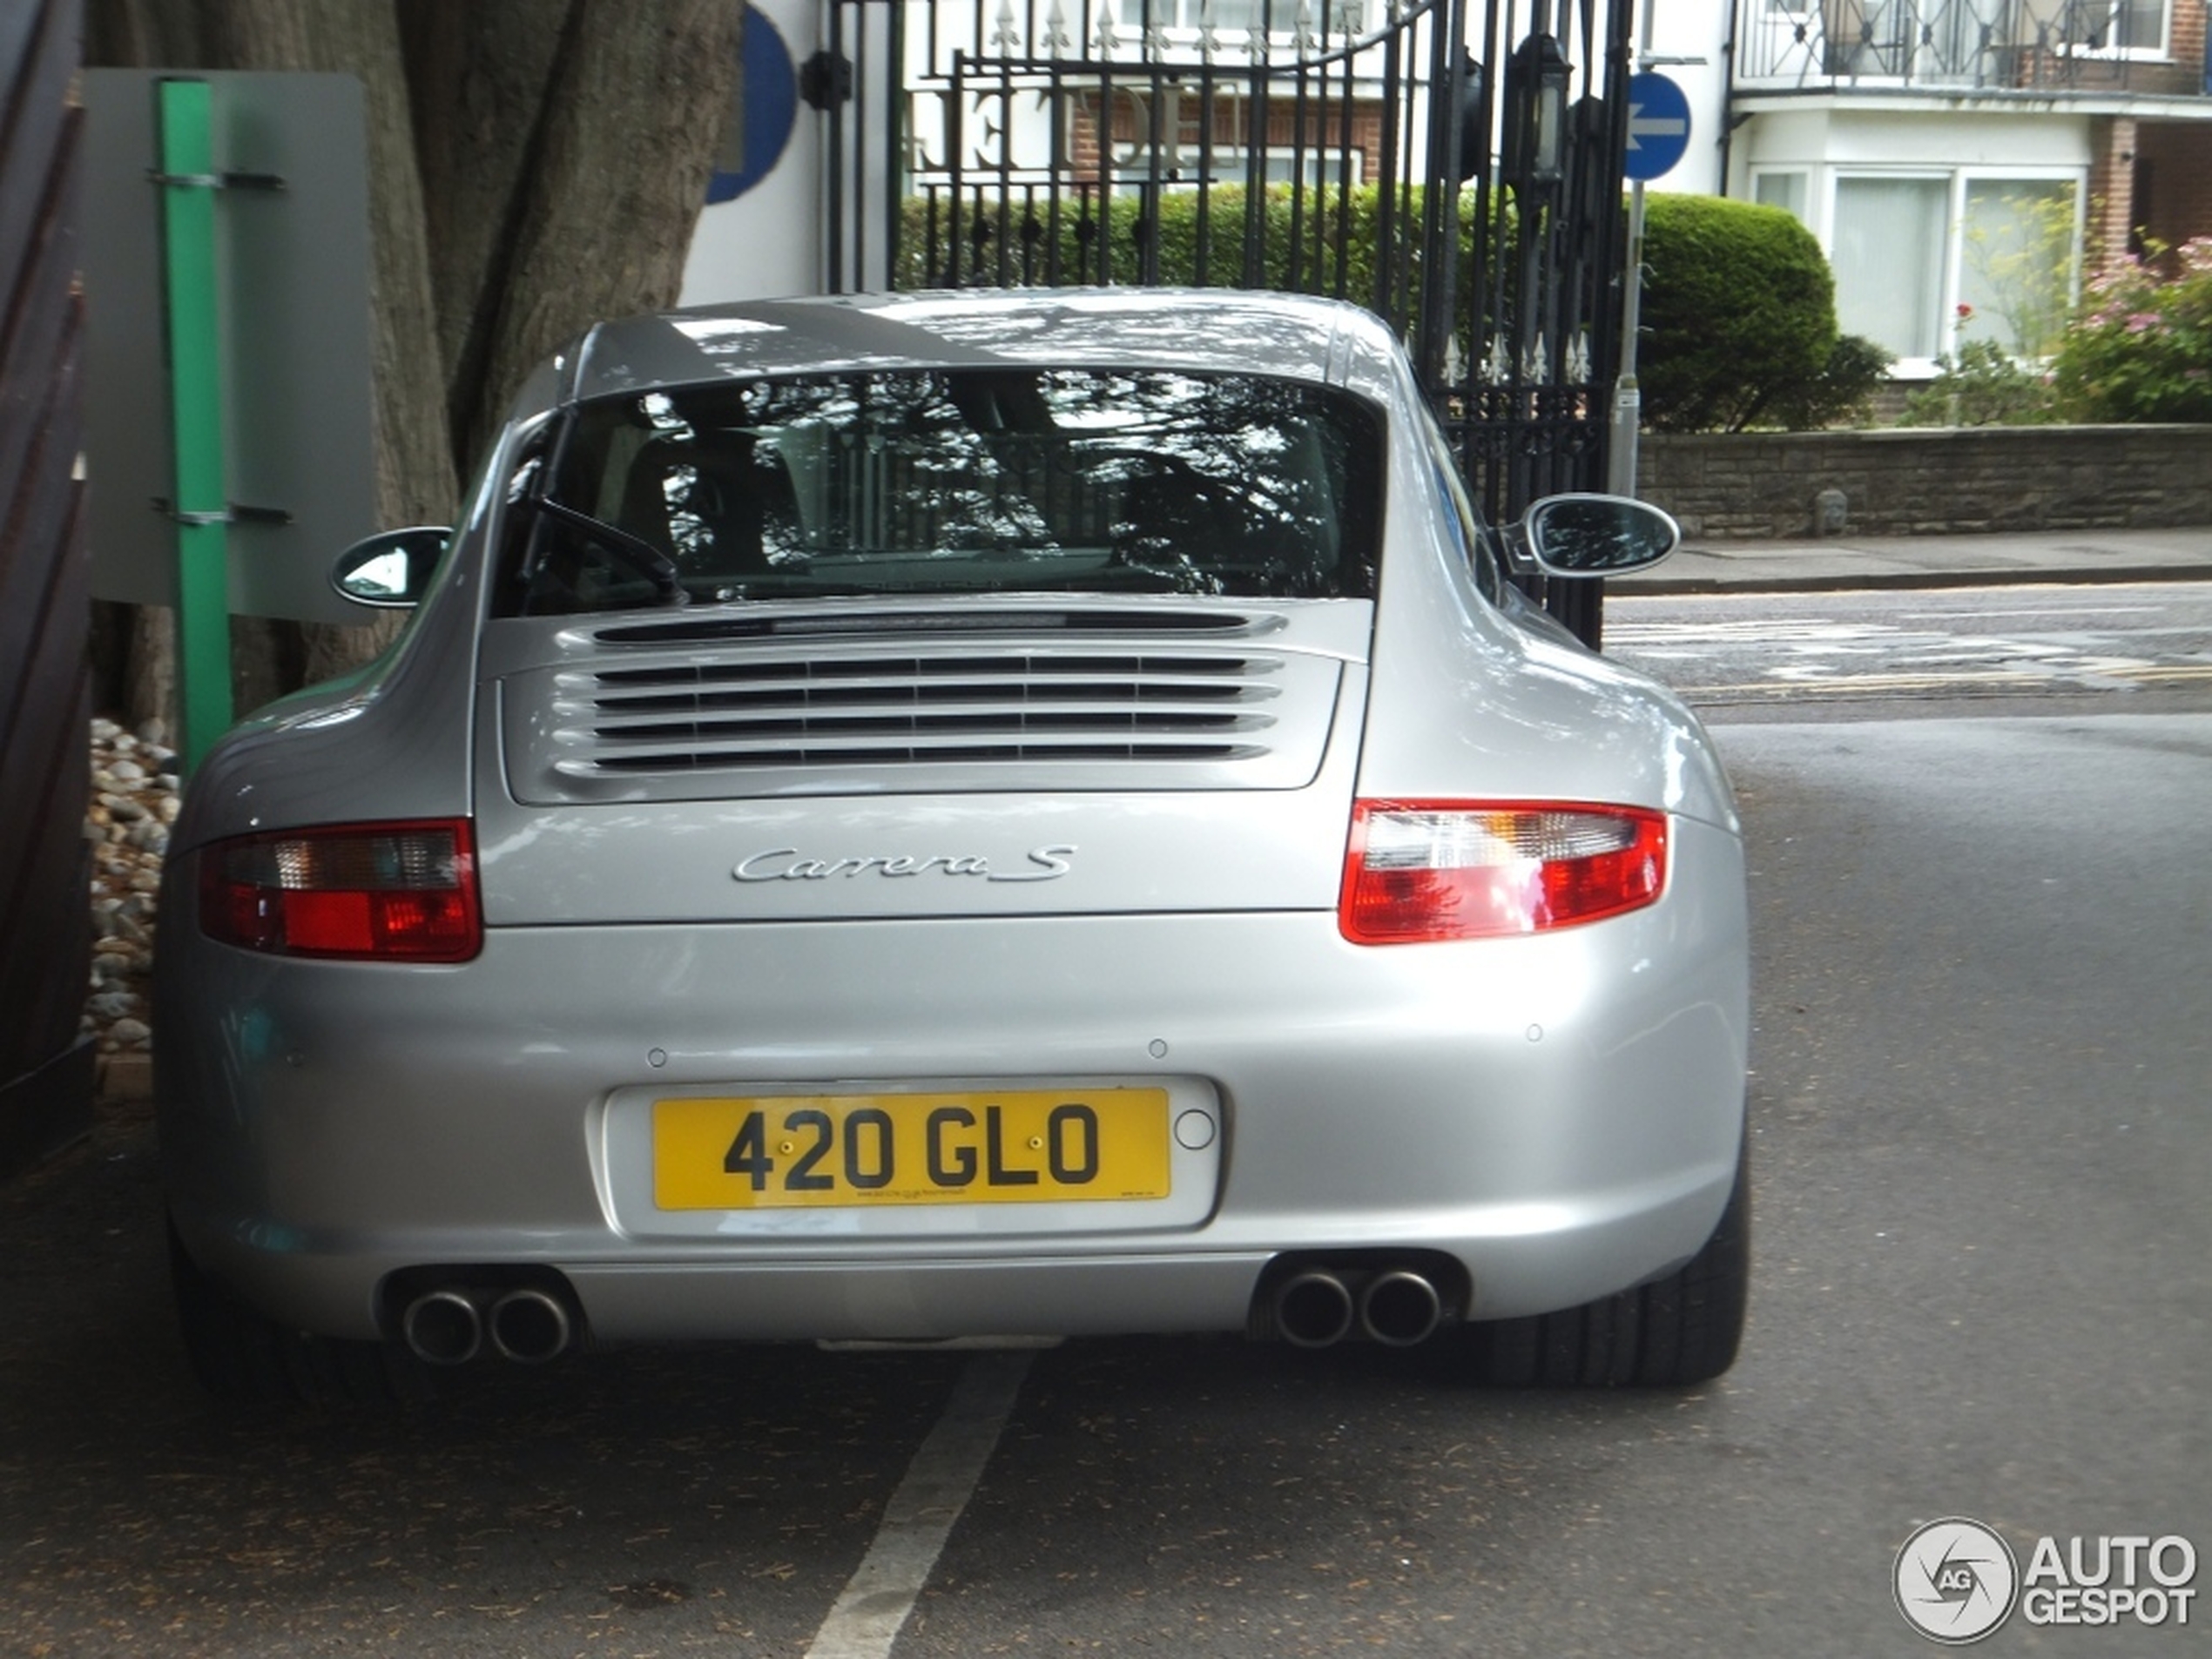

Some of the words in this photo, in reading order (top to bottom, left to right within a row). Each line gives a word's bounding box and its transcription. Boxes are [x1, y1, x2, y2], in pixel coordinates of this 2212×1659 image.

[732, 847, 988, 883] Carrera
[987, 843, 1078, 882] S
[724, 1109, 894, 1191] 420
[926, 1104, 1099, 1187] GLO
